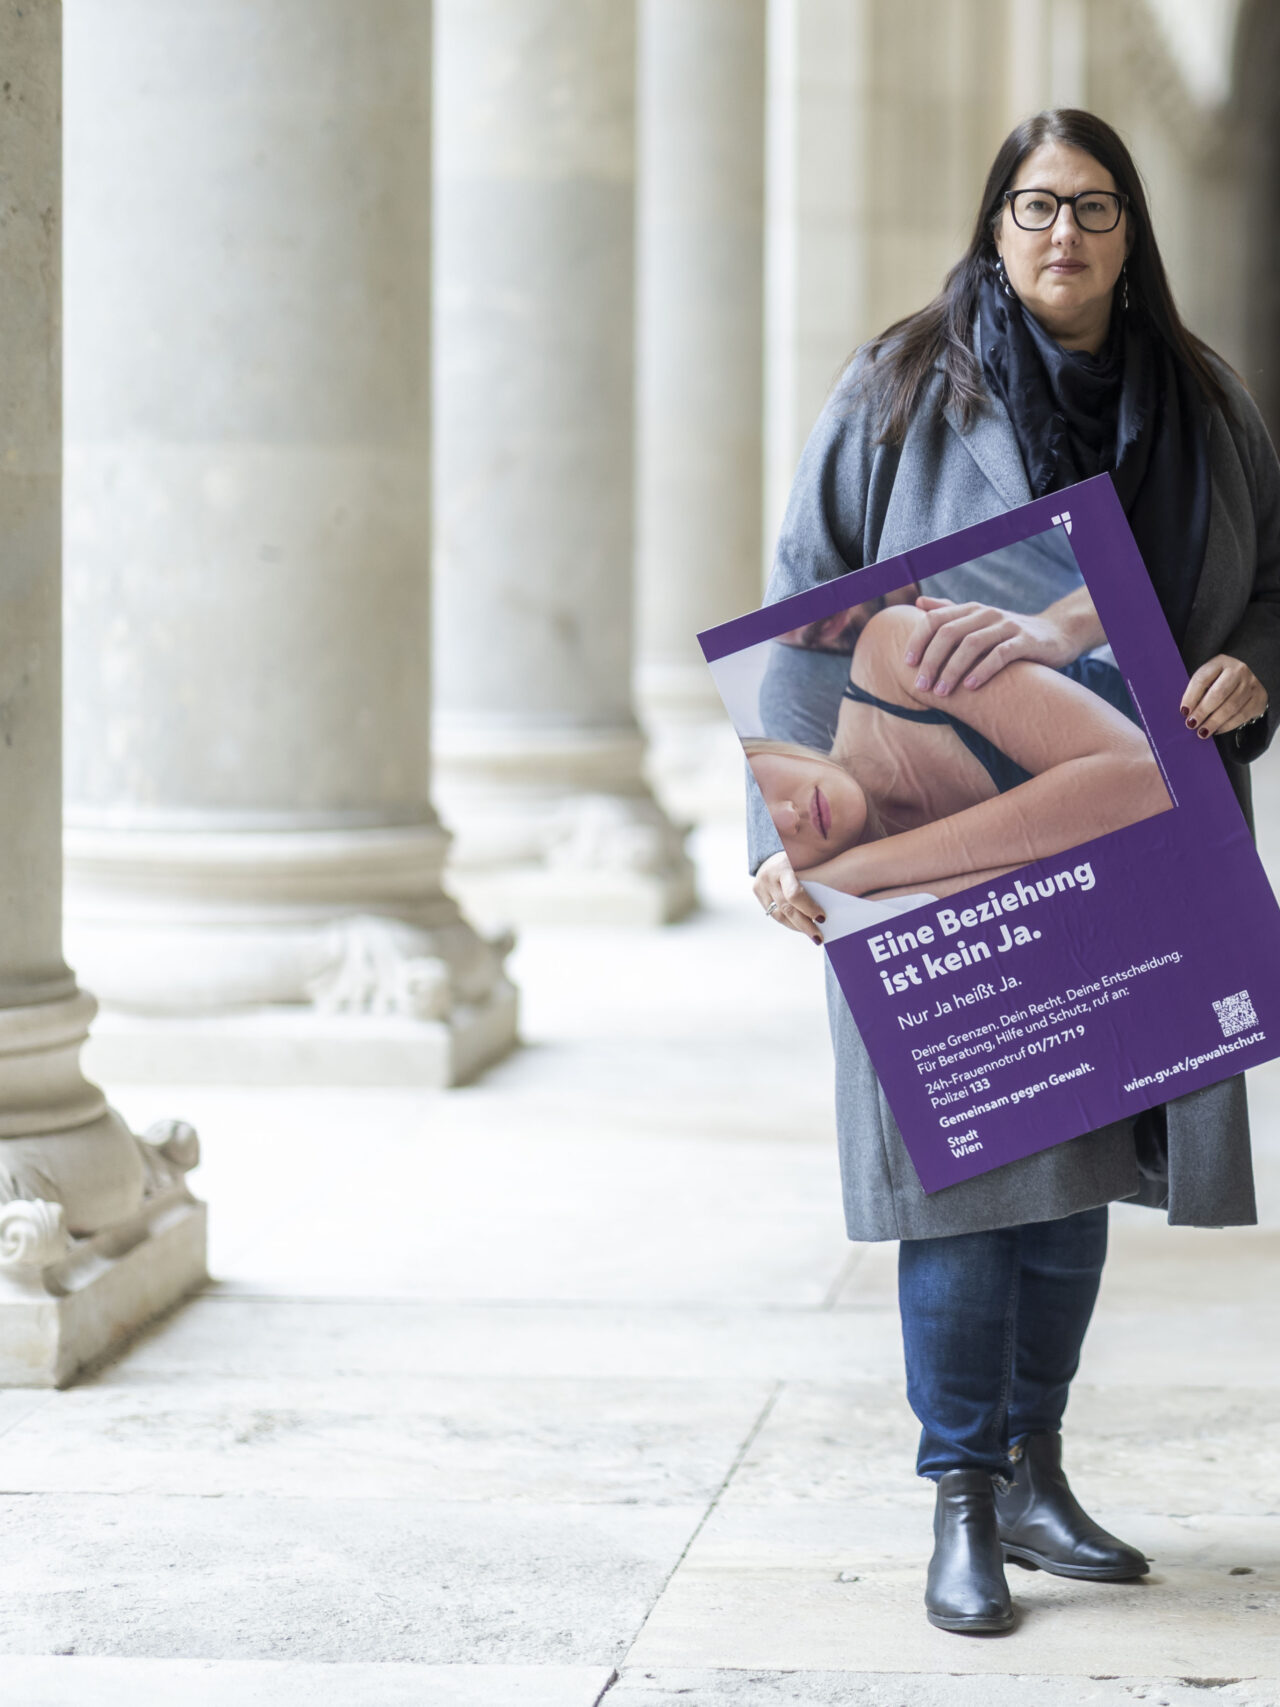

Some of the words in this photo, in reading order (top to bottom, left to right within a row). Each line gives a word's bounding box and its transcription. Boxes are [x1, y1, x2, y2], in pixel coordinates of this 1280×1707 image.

[866, 925, 935, 964] Eine
[935, 862, 1096, 937] Beziehung
[879, 963, 923, 996] ist
[921, 940, 992, 980] kein
[997, 924, 1042, 953] Ja.
[897, 1009, 929, 1031] Nur
[934, 1001, 953, 1018] Ja
[952, 983, 997, 1009] heißt
[999, 975, 1023, 992] Ja.
[911, 1042, 947, 1061] Deine
[947, 1023, 1000, 1047] Grenzen.
[999, 1010, 1029, 1027] Dein
[1027, 995, 1066, 1016] Recht.
[1065, 982, 1101, 1001] Deine
[1101, 951, 1183, 988] Entscheidung.
[916, 1061, 937, 1075] Für
[937, 1040, 996, 1067] Beratung,
[995, 1027, 1024, 1045] Hilfe
[1024, 1015, 1049, 1034] und
[1048, 1003, 1092, 1025] Schutz,
[1092, 991, 1110, 1008] ruf
[1111, 987, 1130, 1000] an:
[924, 1046, 1026, 1095] 24h-Frauennotruf
[930, 1086, 969, 1109] Polizei
[969, 1077, 991, 1094] 133
[1123, 1031, 1266, 1093] wien.gv.at/gewaltschutz
[939, 1096, 1010, 1128] Gemeinsam
[1010, 1081, 1049, 1105] gegen
[1048, 1062, 1095, 1086] Gewalt.
[947, 1129, 979, 1148] Stadt
[950, 1141, 984, 1159] Wien
